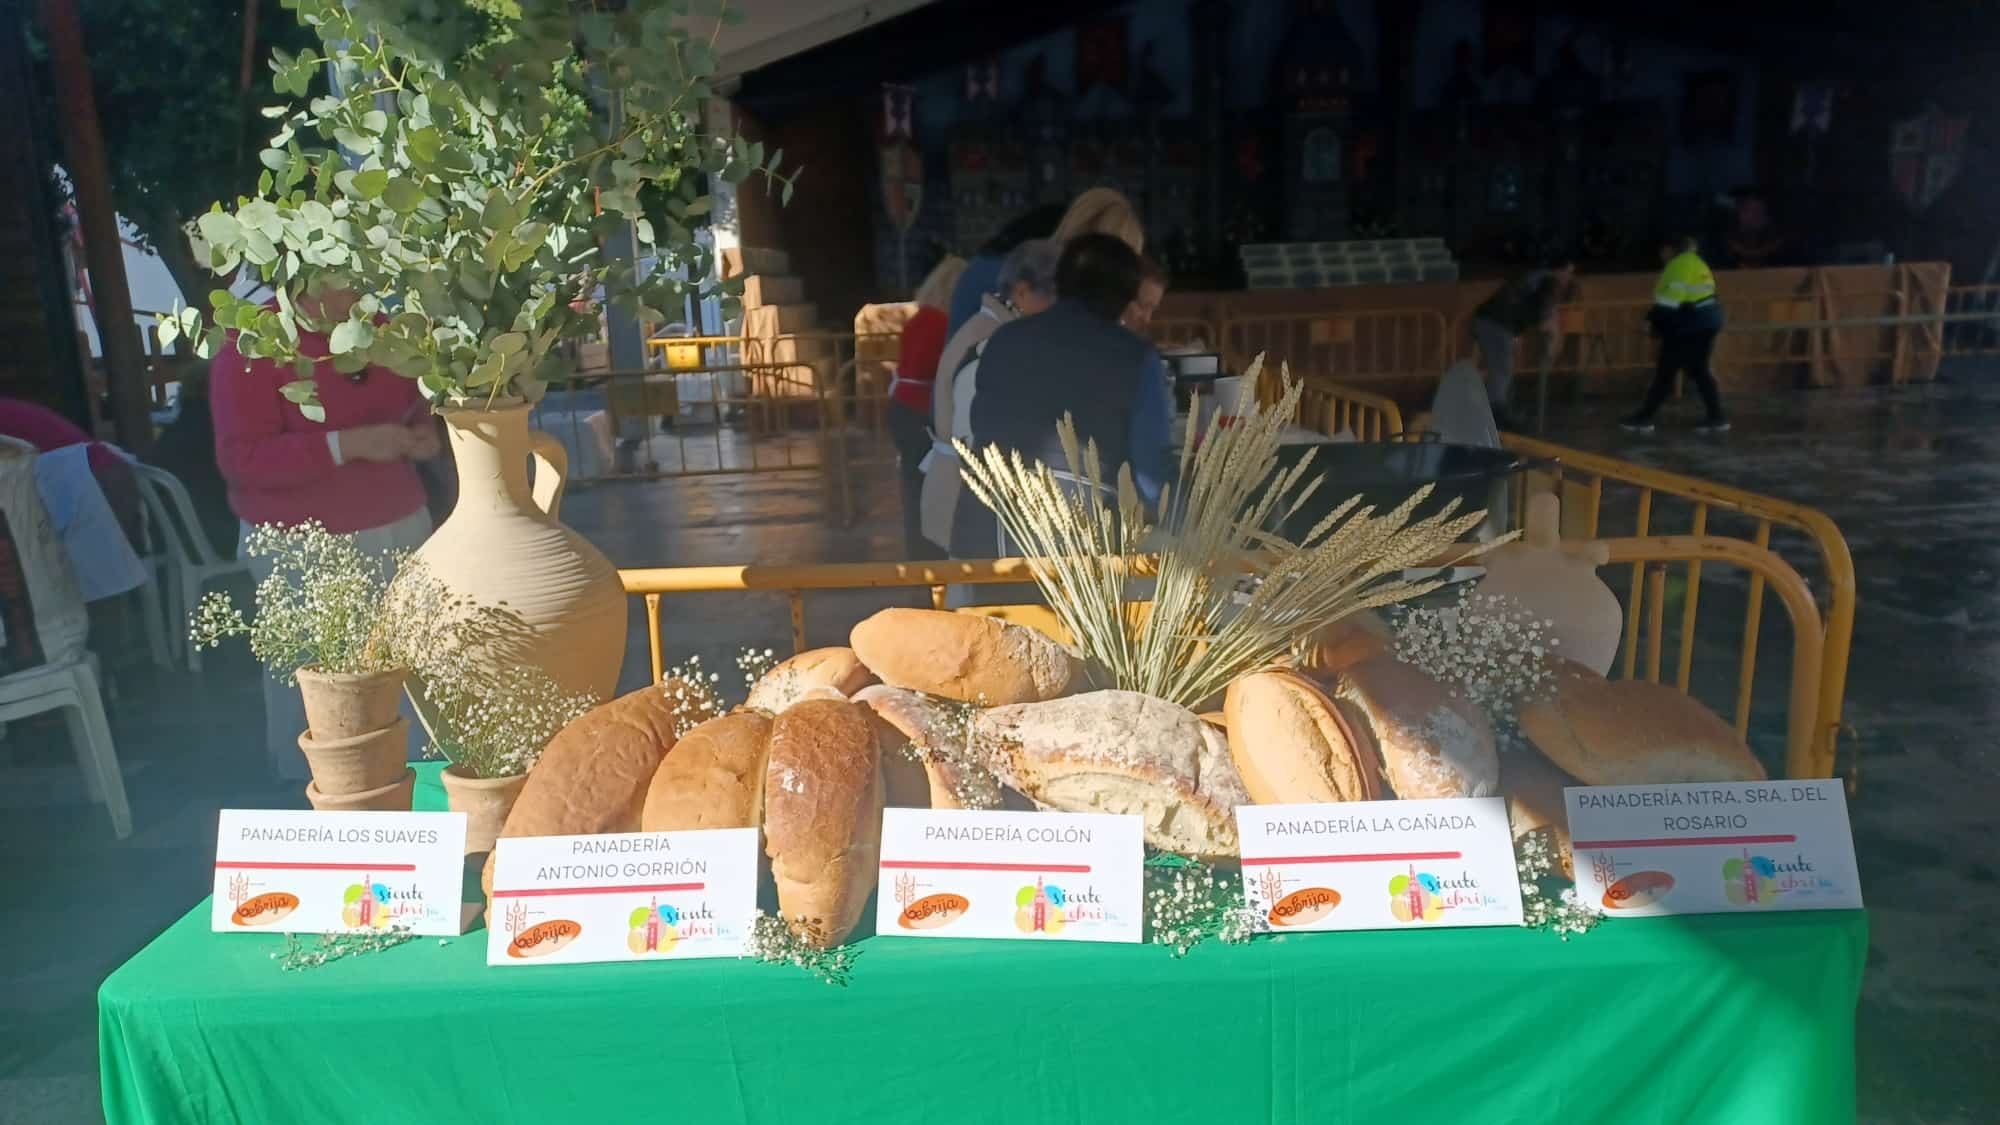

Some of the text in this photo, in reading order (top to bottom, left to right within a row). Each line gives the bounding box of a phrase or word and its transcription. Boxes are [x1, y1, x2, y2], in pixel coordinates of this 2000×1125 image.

[1579, 787, 1828, 809] PANADERÍA NTRA. SRA. DEL
[1265, 813, 1478, 836] PANADERÍA LA CAÑADA
[1663, 814, 1748, 831] ROSARIO
[240, 825, 438, 844] PANADERÍA LOS SUAVES
[925, 825, 1092, 843] PANADERÍA COLÓN
[572, 836, 672, 855] PANADERÍA
[536, 857, 707, 881] ANTONIO GORRIÓN
